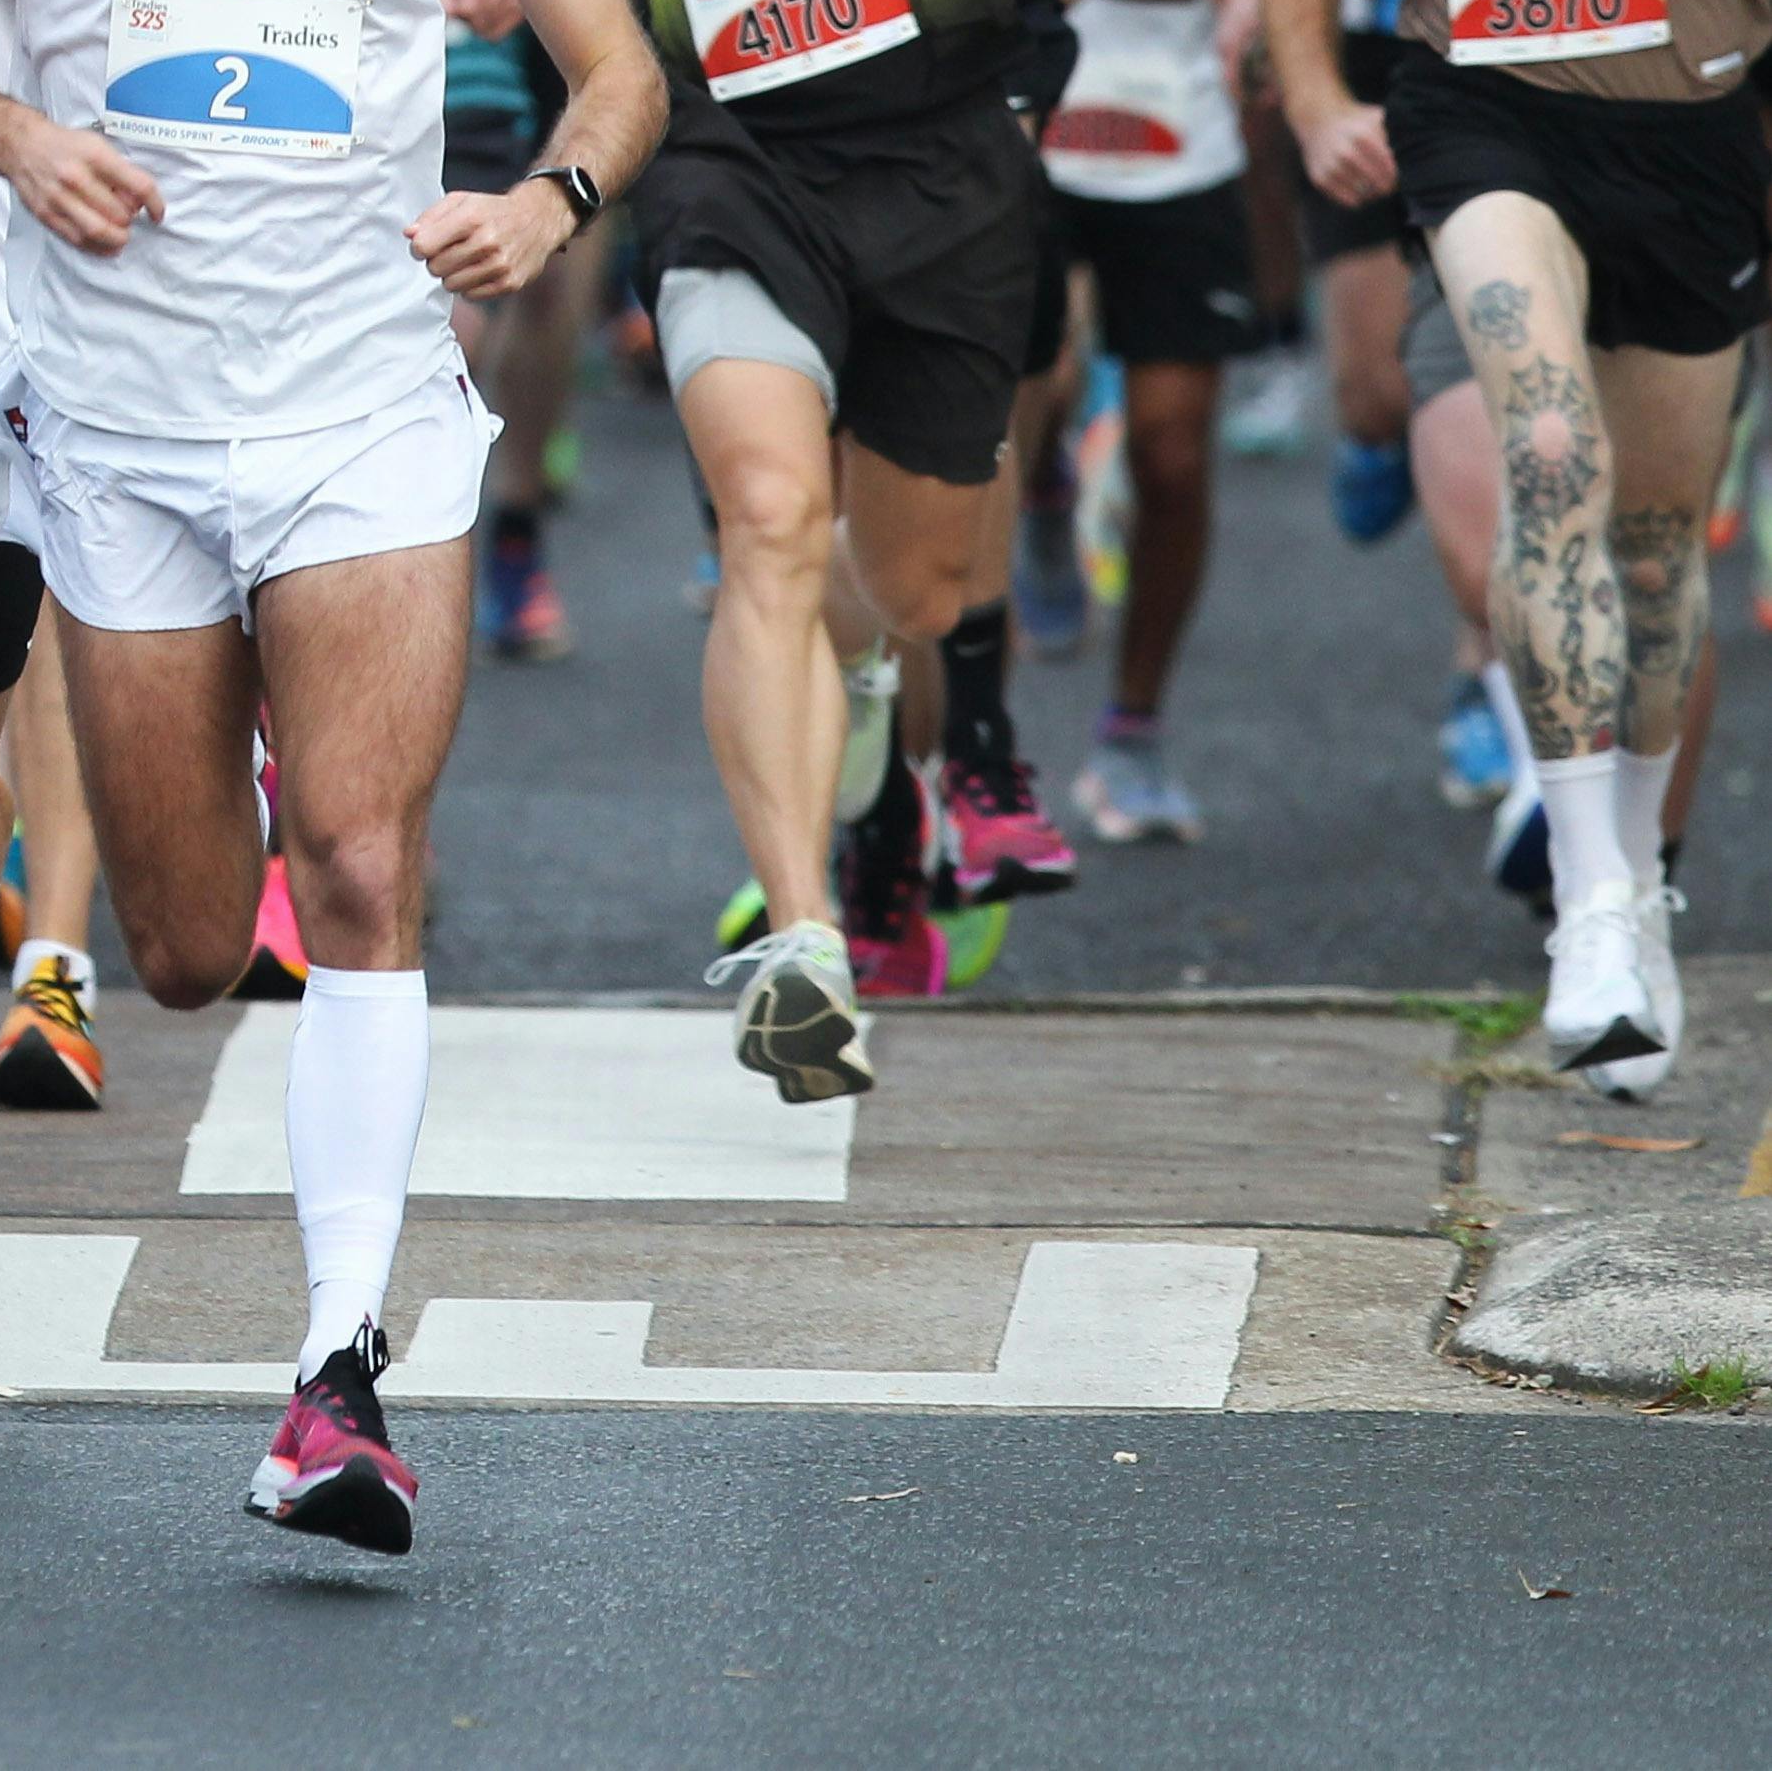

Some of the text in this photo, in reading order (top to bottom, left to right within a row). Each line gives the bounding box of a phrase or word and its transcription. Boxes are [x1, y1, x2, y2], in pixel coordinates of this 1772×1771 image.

[128, 8, 168, 32] S2S
[256, 21, 340, 50] Tradies
[208, 54, 251, 122] 2
[119, 119, 290, 148] BROOKS PRO SPRINT BROOKS
